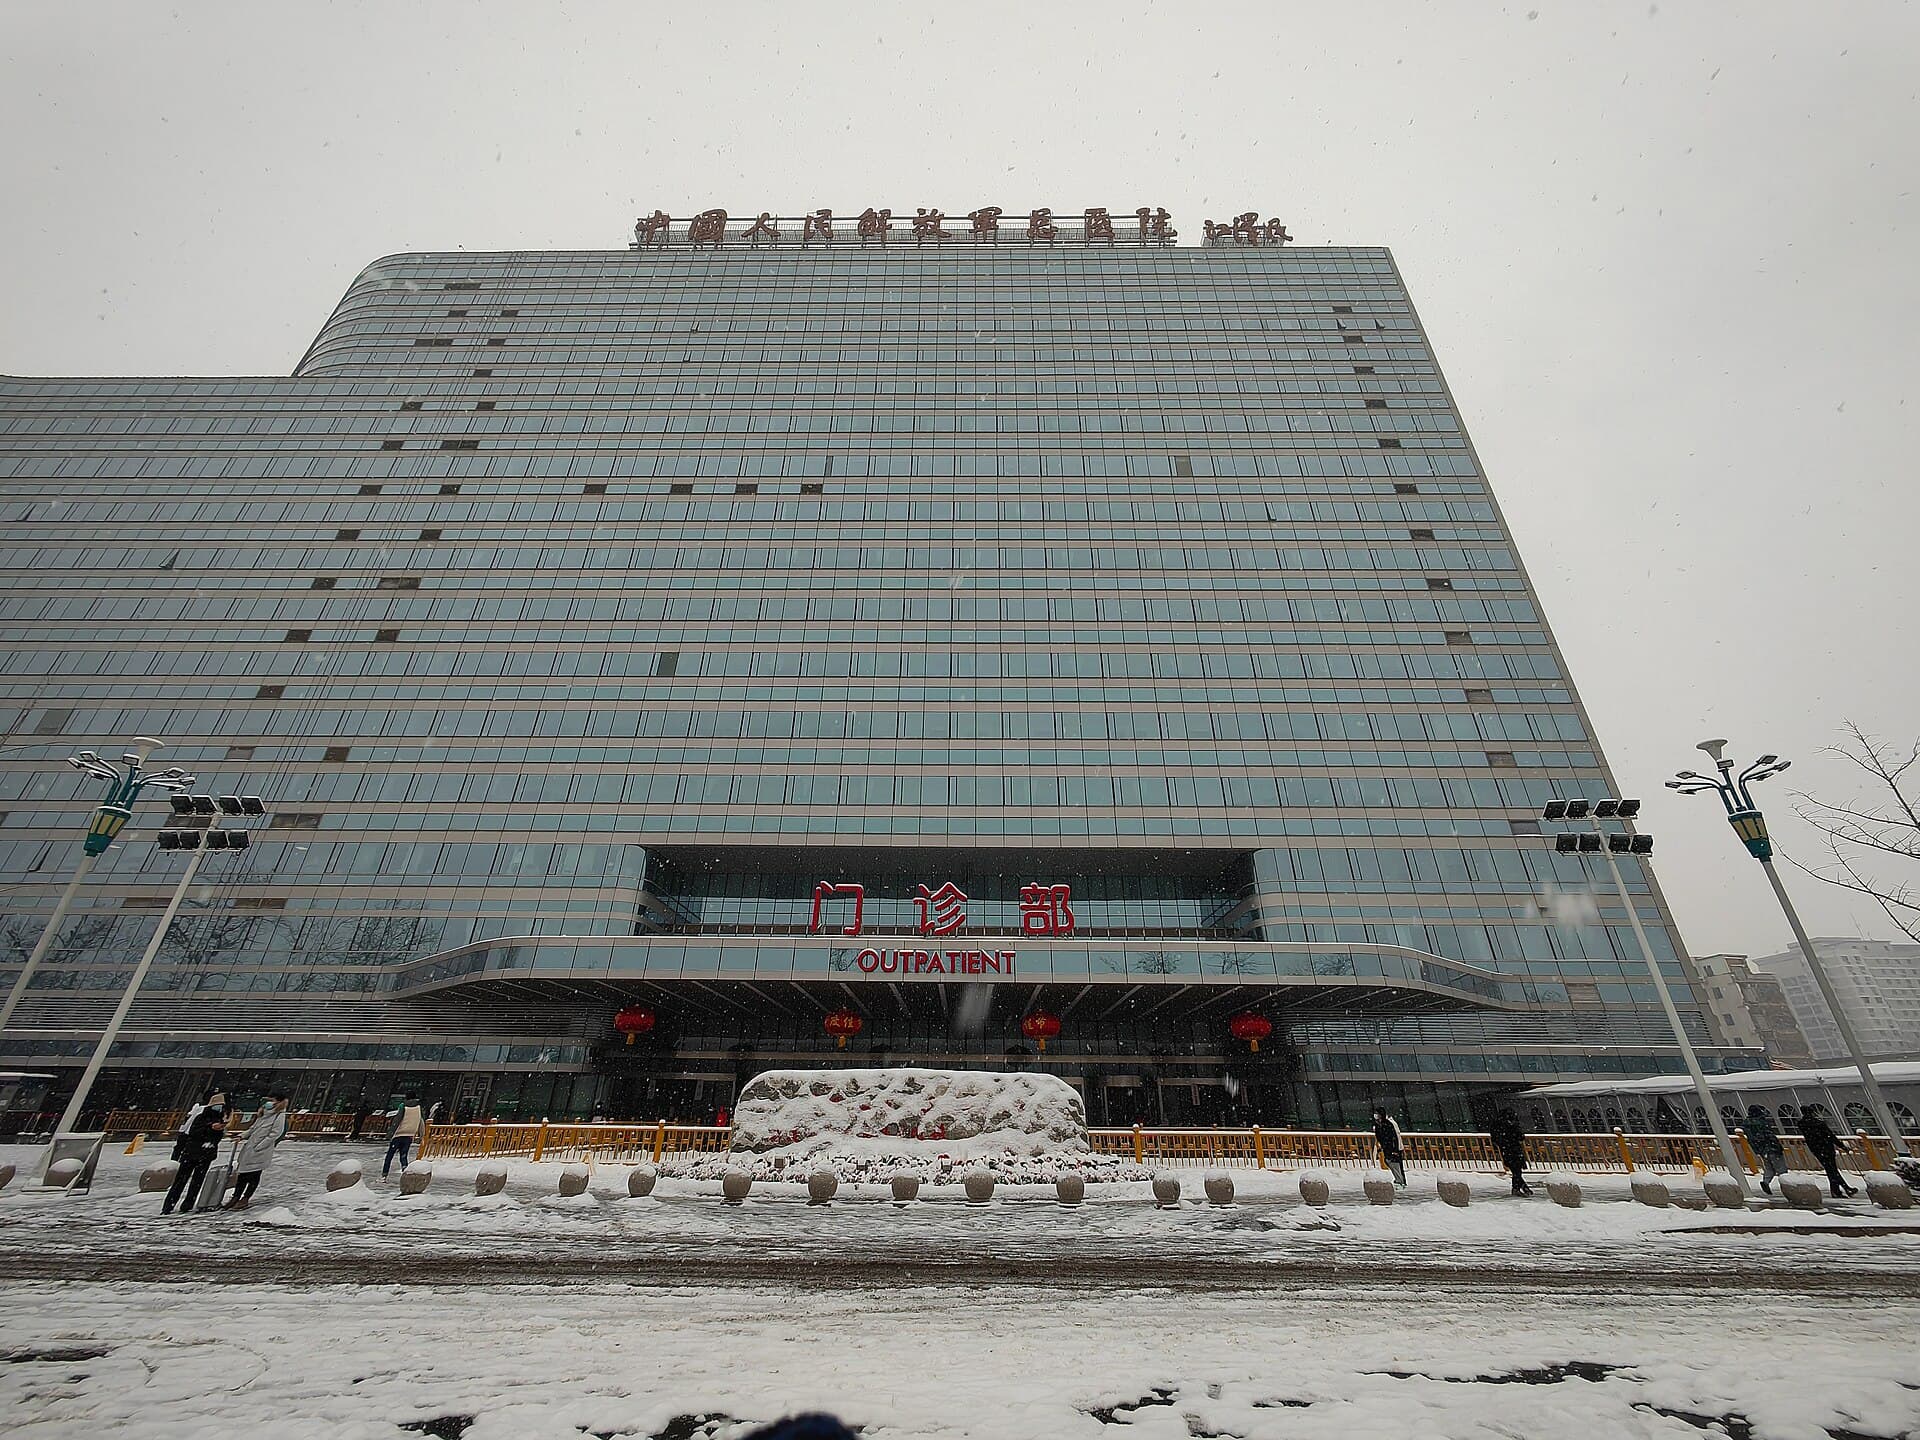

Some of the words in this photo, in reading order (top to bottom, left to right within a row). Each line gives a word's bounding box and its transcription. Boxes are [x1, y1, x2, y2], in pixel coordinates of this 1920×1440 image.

[811, 882, 1074, 936] 门诊部
[858, 950, 1015, 974] OUTPATIENT
